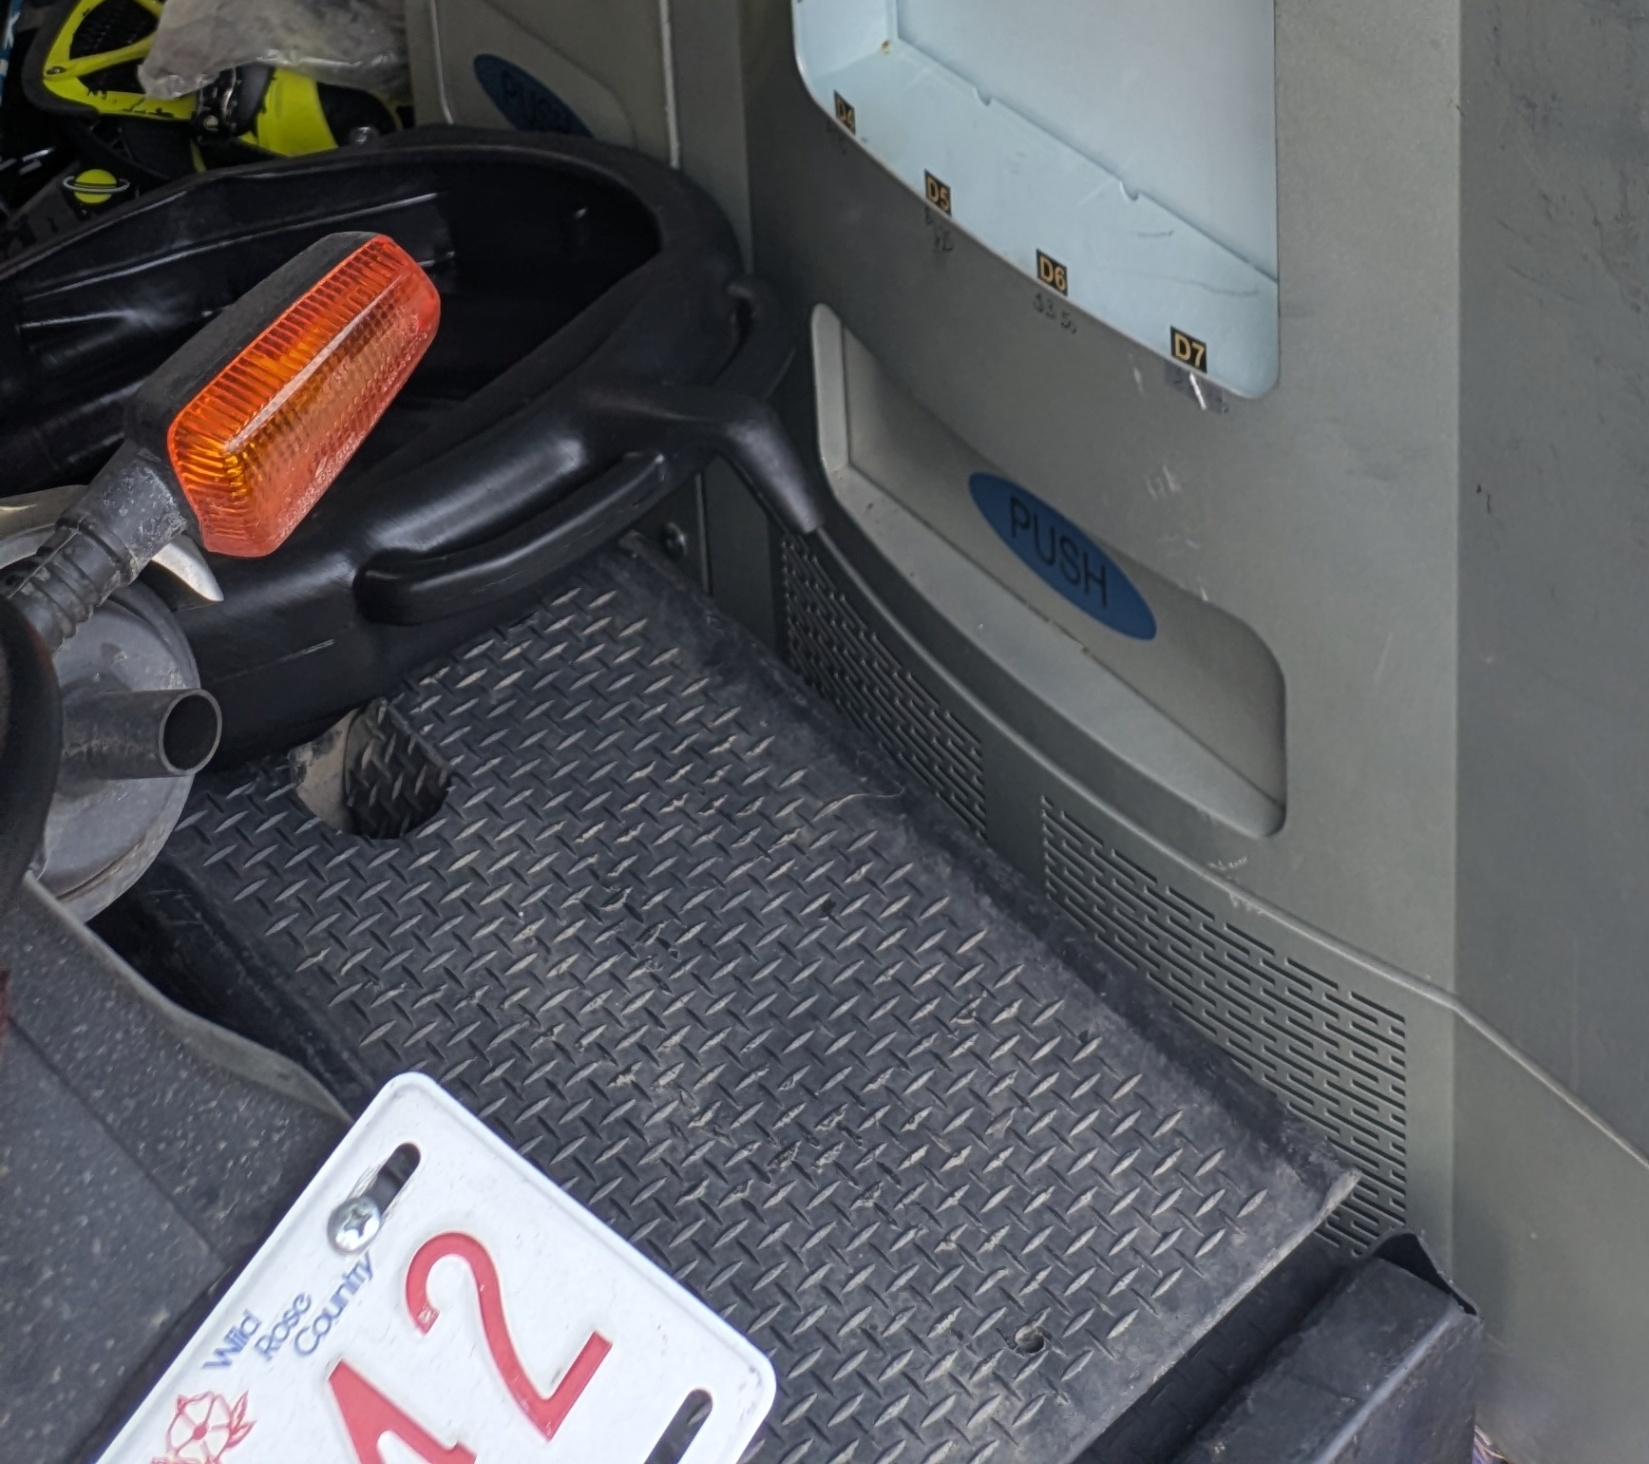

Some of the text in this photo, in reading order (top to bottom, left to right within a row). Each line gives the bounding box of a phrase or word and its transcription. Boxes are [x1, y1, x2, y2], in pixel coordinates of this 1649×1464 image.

[837, 98, 854, 125] D4
[927, 176, 950, 211] D5
[1039, 255, 1066, 292] D6
[1174, 331, 1205, 367] D7
[1010, 495, 1107, 608] PUSH
[253, 1290, 313, 1361] Rose
[293, 1251, 376, 1357] Country
[202, 1309, 262, 1370] Wild
